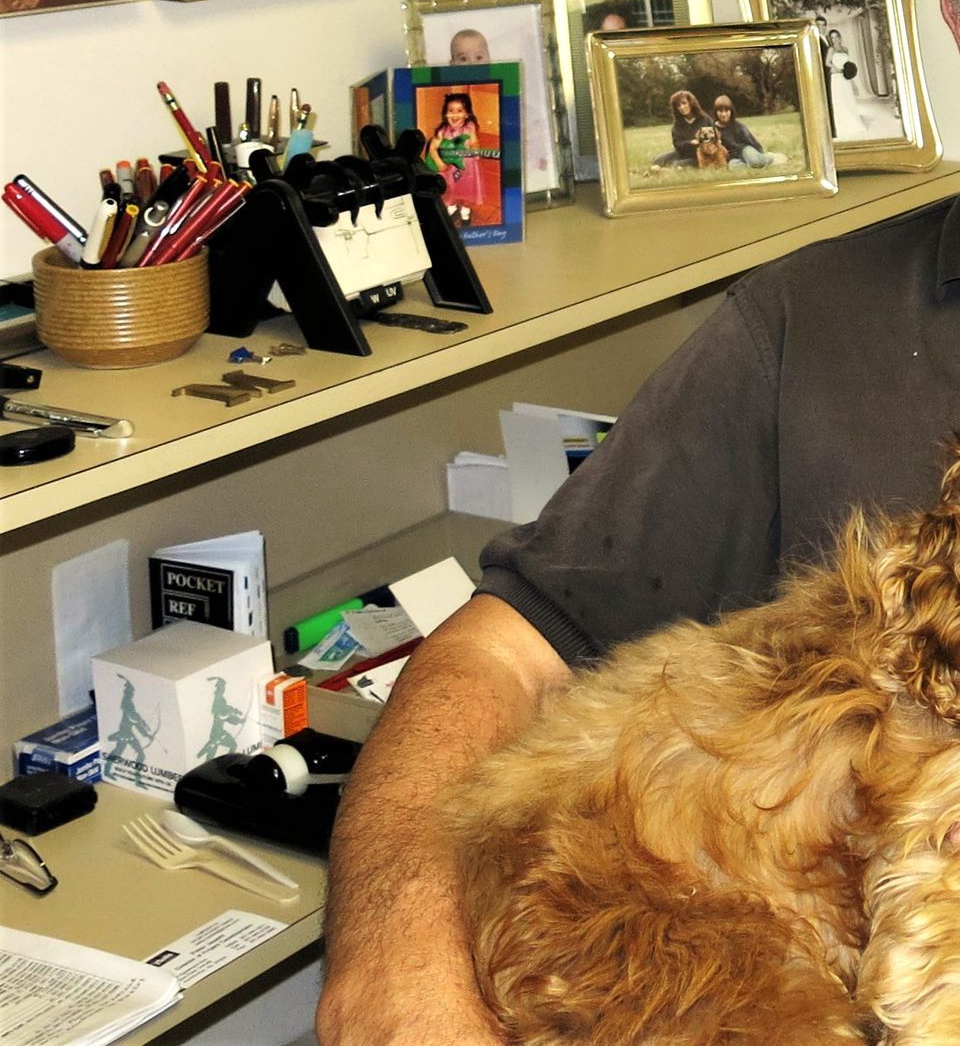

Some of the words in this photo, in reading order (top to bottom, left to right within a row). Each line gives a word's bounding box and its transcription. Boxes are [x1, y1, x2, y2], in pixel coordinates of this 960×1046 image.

[369, 294, 381, 305] W
[165, 571, 226, 595] POCKET
[167, 598, 197, 617] REF
